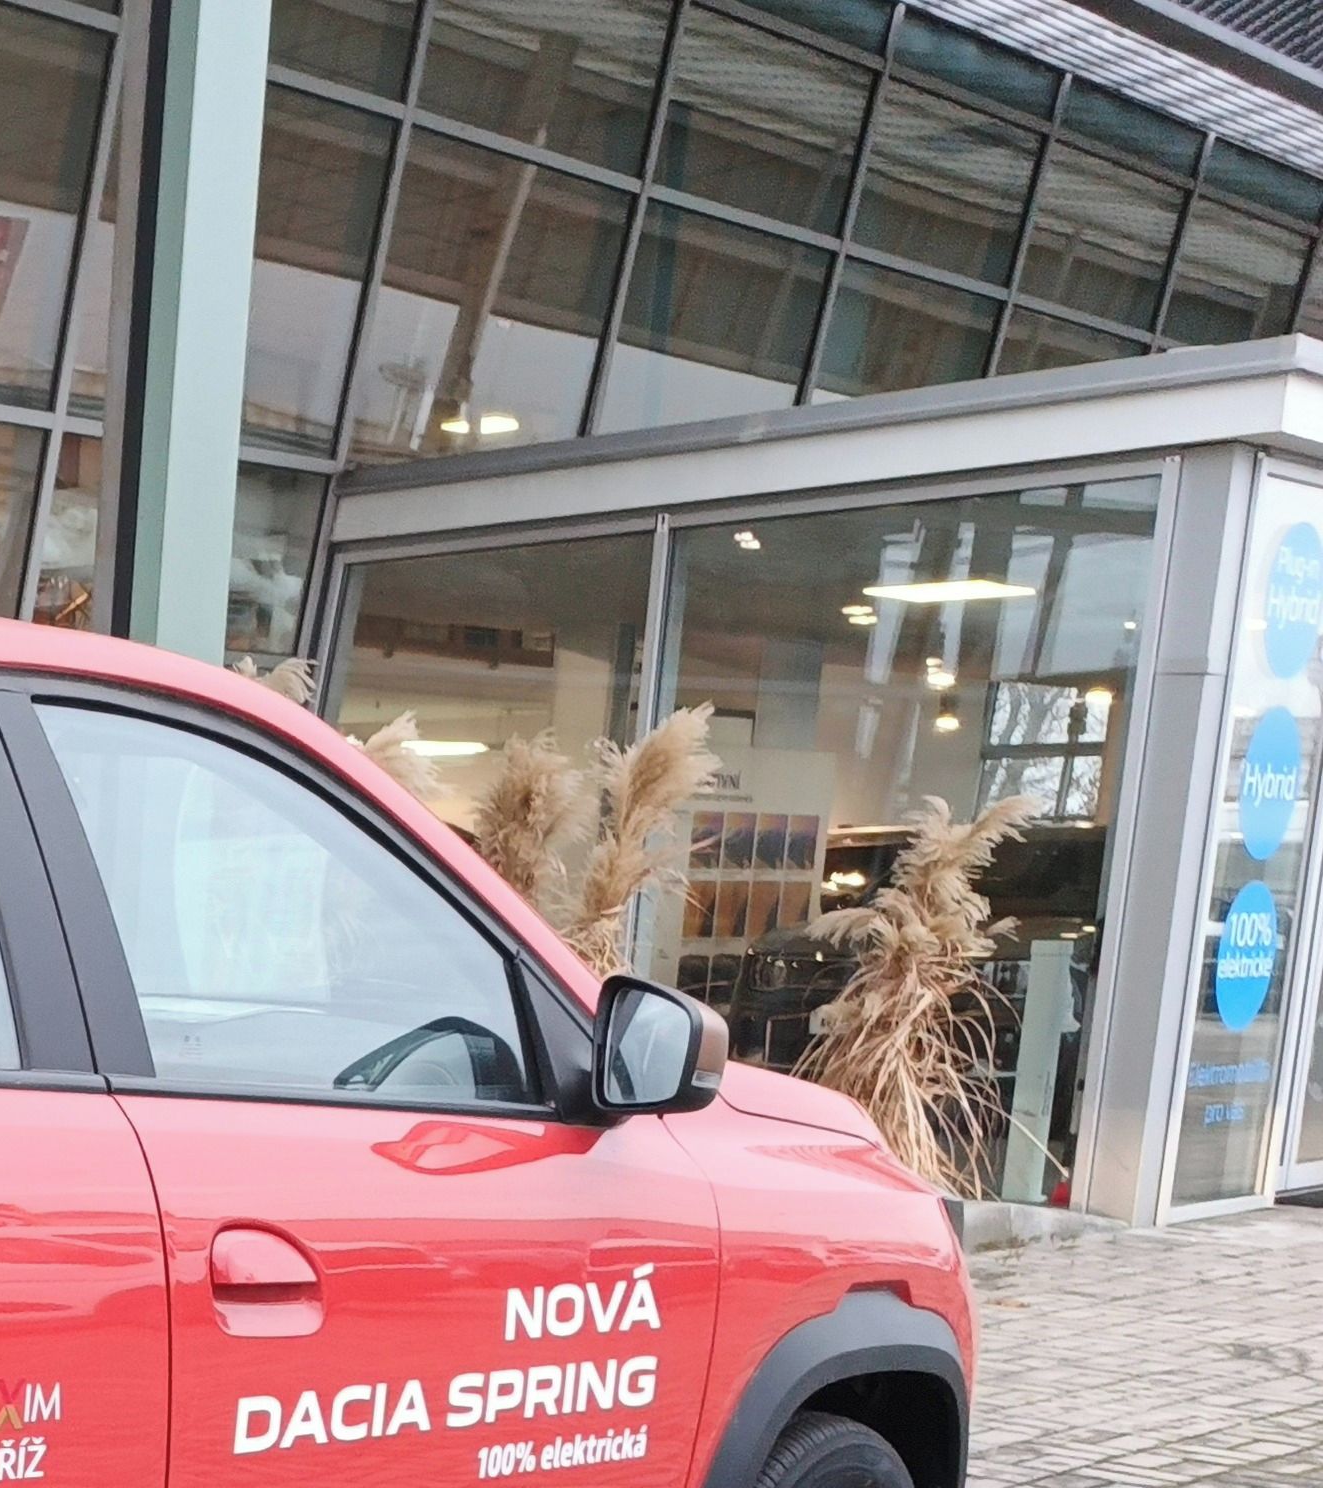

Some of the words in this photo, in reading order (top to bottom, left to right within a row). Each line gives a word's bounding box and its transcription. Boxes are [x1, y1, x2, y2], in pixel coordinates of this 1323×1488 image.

[1266, 586, 1322, 629] Hybrid
[1242, 761, 1297, 813] Hybrid
[1229, 912, 1272, 947] 100%
[503, 1262, 662, 1342] NOVÁ
[233, 1377, 433, 1456] DACIA
[444, 1355, 658, 1430] SPRING
[476, 1444, 537, 1481] 100%
[539, 1424, 649, 1472] elektrická
